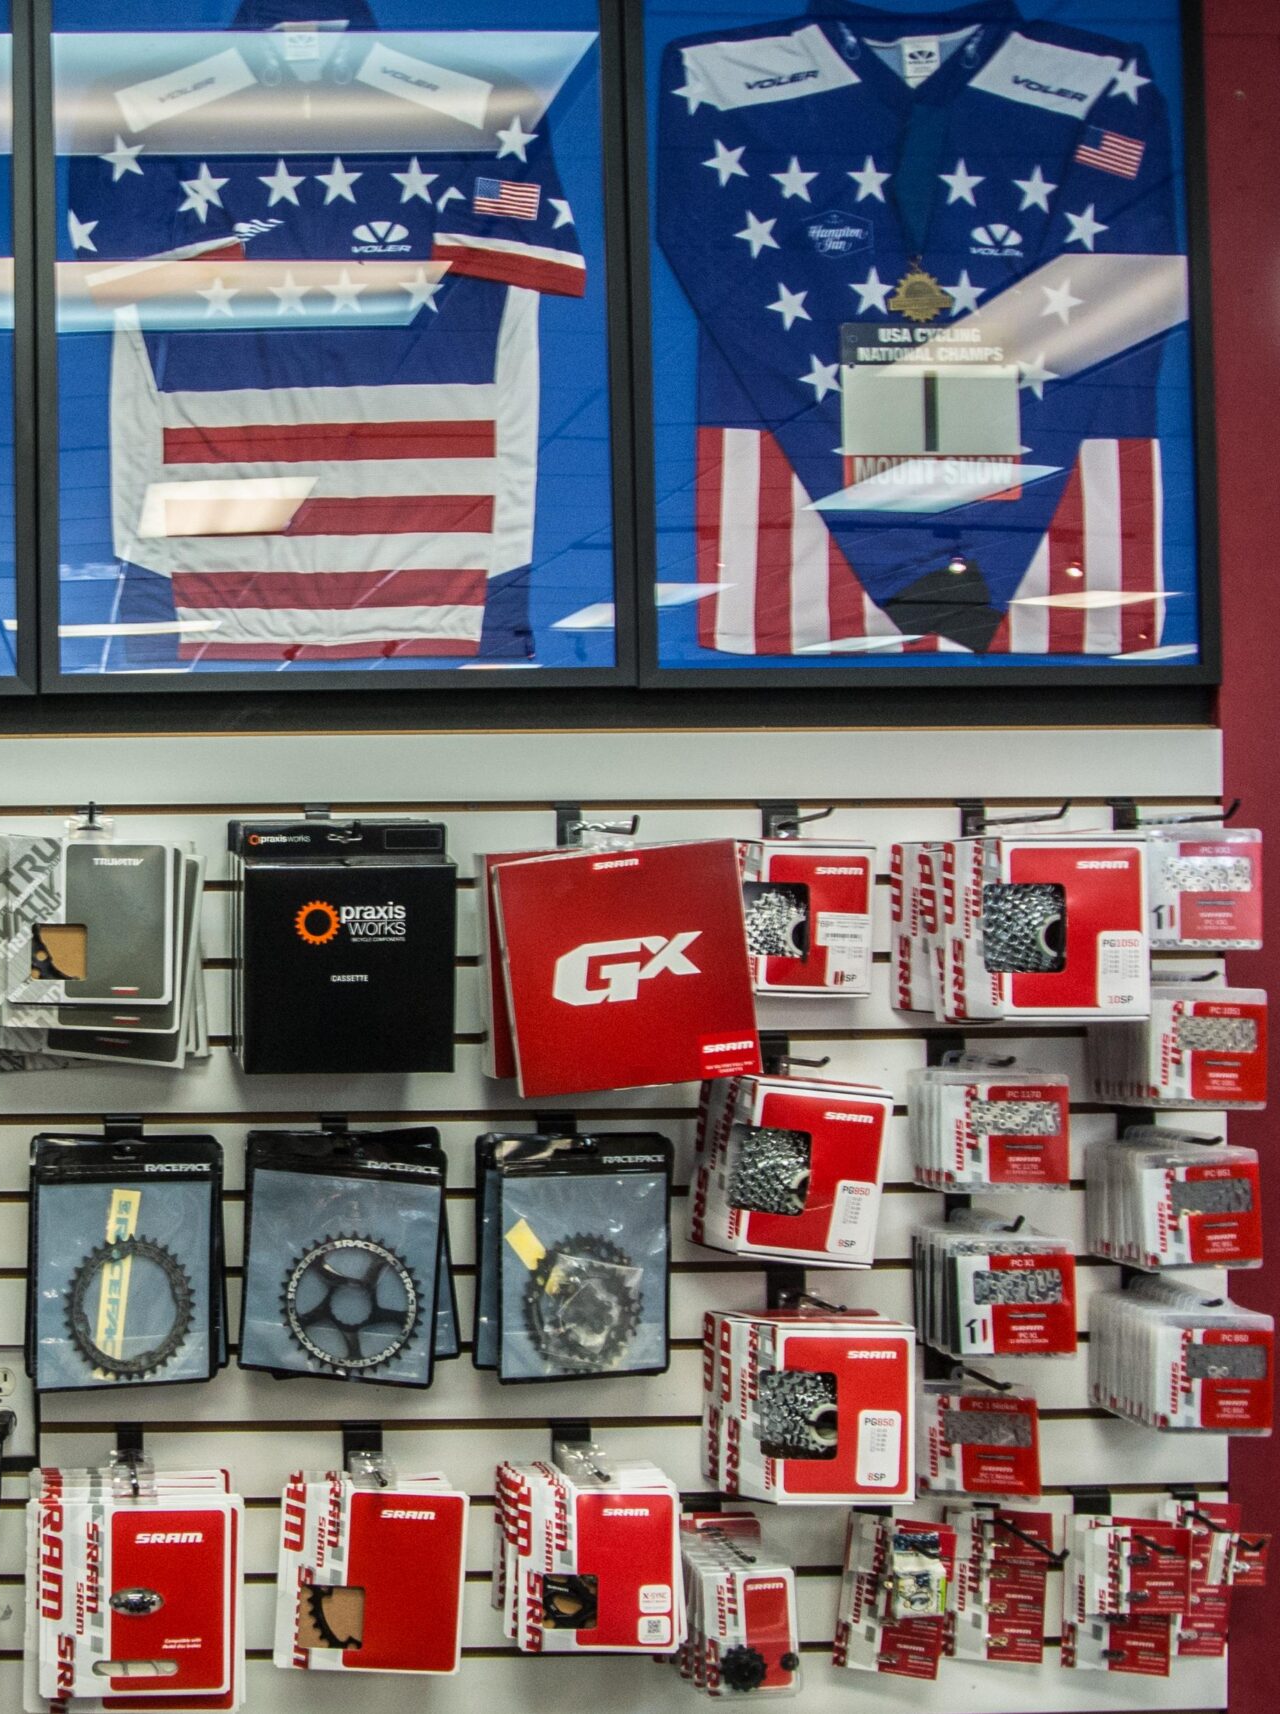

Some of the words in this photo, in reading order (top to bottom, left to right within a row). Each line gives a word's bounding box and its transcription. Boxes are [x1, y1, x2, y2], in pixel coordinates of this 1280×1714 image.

[380, 66, 440, 94] VOLER
[744, 69, 819, 92] VOLER
[157, 76, 217, 104] VOLER
[1011, 75, 1089, 102] VOLER
[808, 224, 868, 241] Hampton
[352, 244, 412, 253] VOLER
[878, 328, 911, 343] USA
[914, 327, 981, 343] CYCLING
[856, 347, 934, 362] NATIONAL
[936, 347, 1004, 362] CHAMPS
[853, 457, 938, 485] MOUNT
[942, 457, 1013, 485] SNOW
[93, 857, 144, 866] TRUVATIV
[593, 857, 639, 871] SRAM
[1076, 860, 1129, 870] SRAM
[815, 866, 864, 876] SRAM
[340, 901, 407, 924] praxis
[347, 922, 407, 936] works
[1103, 938, 1140, 948] PG1050
[552, 929, 704, 1007] GX
[331, 974, 369, 982] CASSETTE
[1108, 994, 1135, 1004] 10SP
[702, 1040, 754, 1054] SRAM
[1006, 1090, 1020, 1098] PC
[824, 1111, 874, 1123] SRAM
[603, 1155, 665, 1164] RACEFACE
[144, 1163, 211, 1173] RACEFACE
[367, 1160, 441, 1174] RACEFACE
[1010, 1259, 1022, 1267] PC
[1221, 1334, 1233, 1342] PC
[847, 1350, 897, 1360] SRAM
[972, 1401, 984, 1409] PC
[380, 1509, 436, 1520] SRAM
[602, 1508, 650, 1517] SRAM
[135, 1532, 204, 1544] SRAM
[316, 1516, 326, 1568] SRAM
[545, 1519, 553, 1573] SRAM
[86, 1521, 99, 1615] SRAM
[746, 1582, 784, 1591] SRAM
[958, 1563, 967, 1612] SRAM
[852, 1574, 866, 1624] SRAM
[76, 1582, 85, 1636] SRAM
[716, 1584, 726, 1636] SRAM
